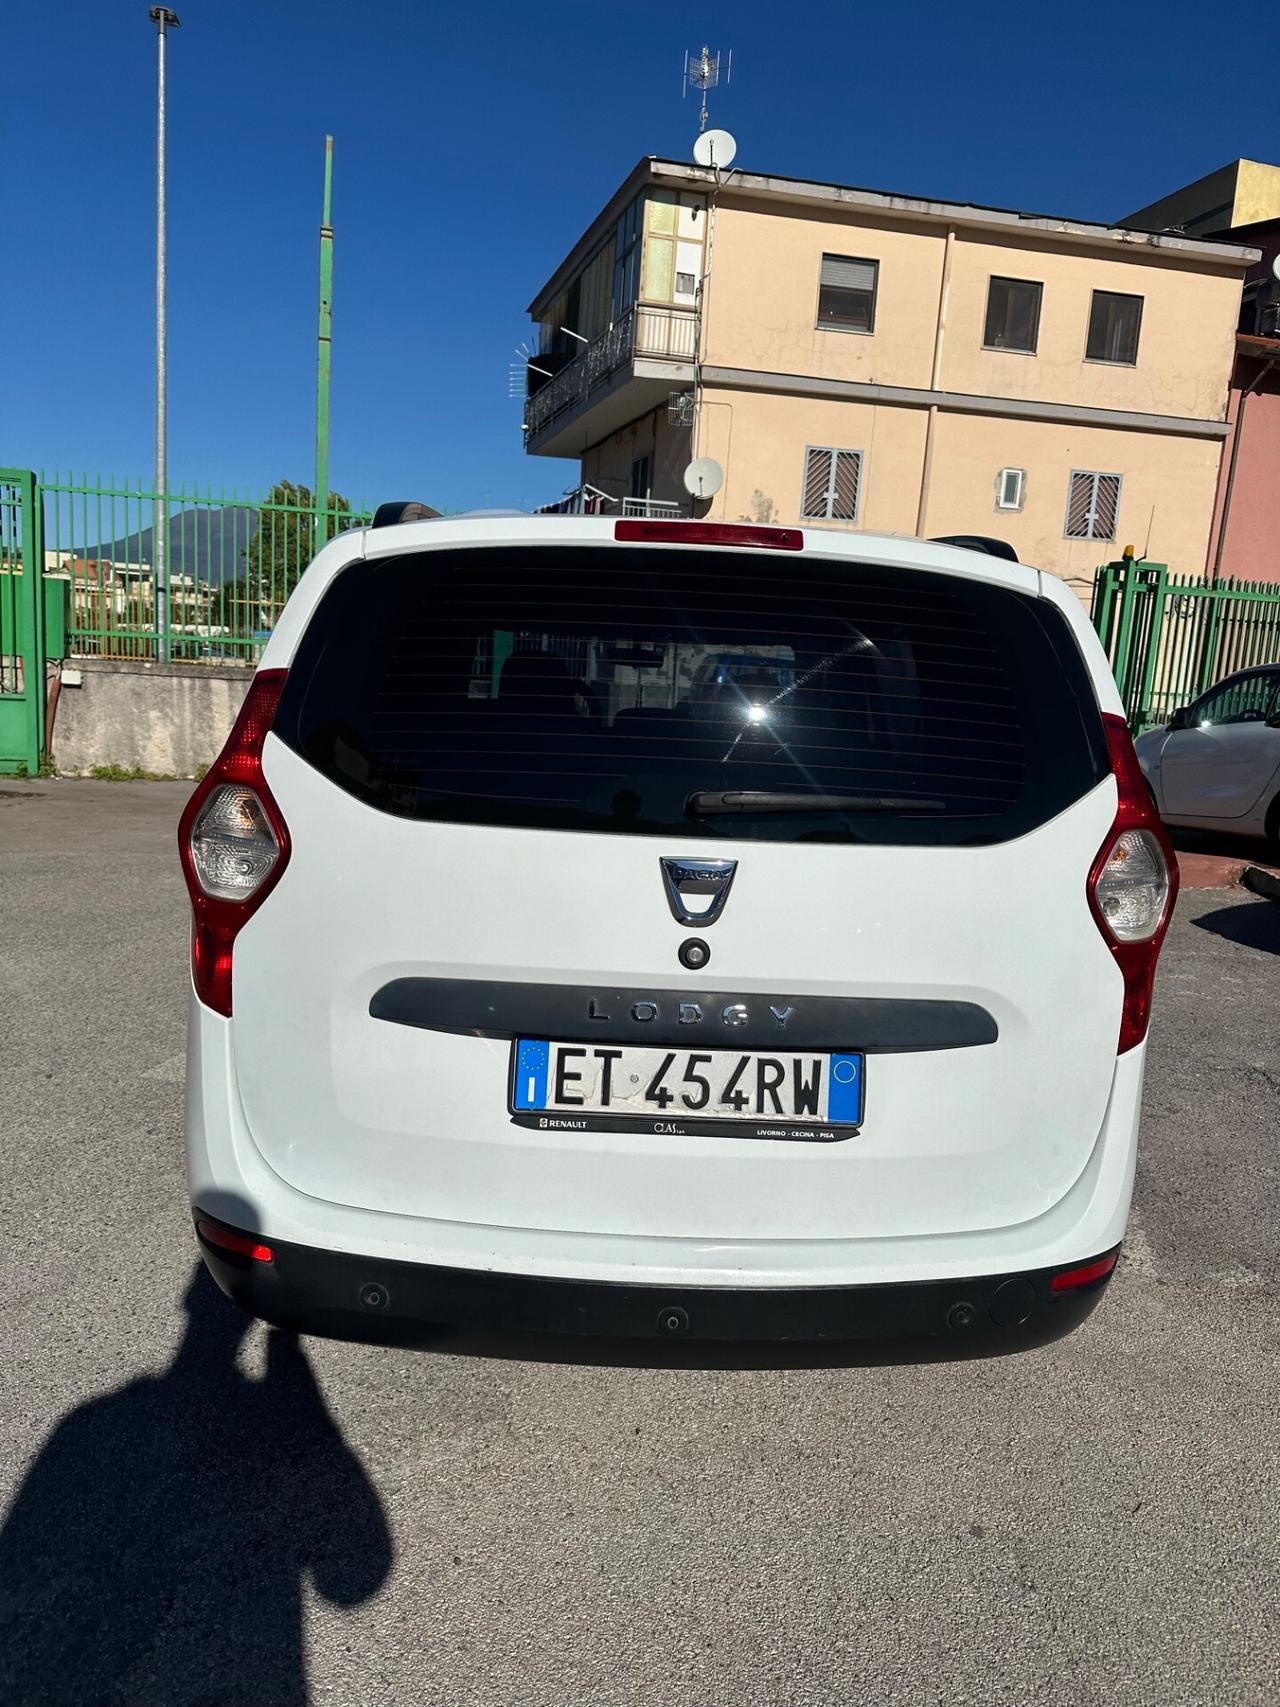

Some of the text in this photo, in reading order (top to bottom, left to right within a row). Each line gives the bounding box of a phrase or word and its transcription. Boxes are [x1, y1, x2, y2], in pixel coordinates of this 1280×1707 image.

[588, 999, 793, 1027] LODGY
[555, 1047, 821, 1115] ET 454RW
[549, 1119, 587, 1129] RENAULT
